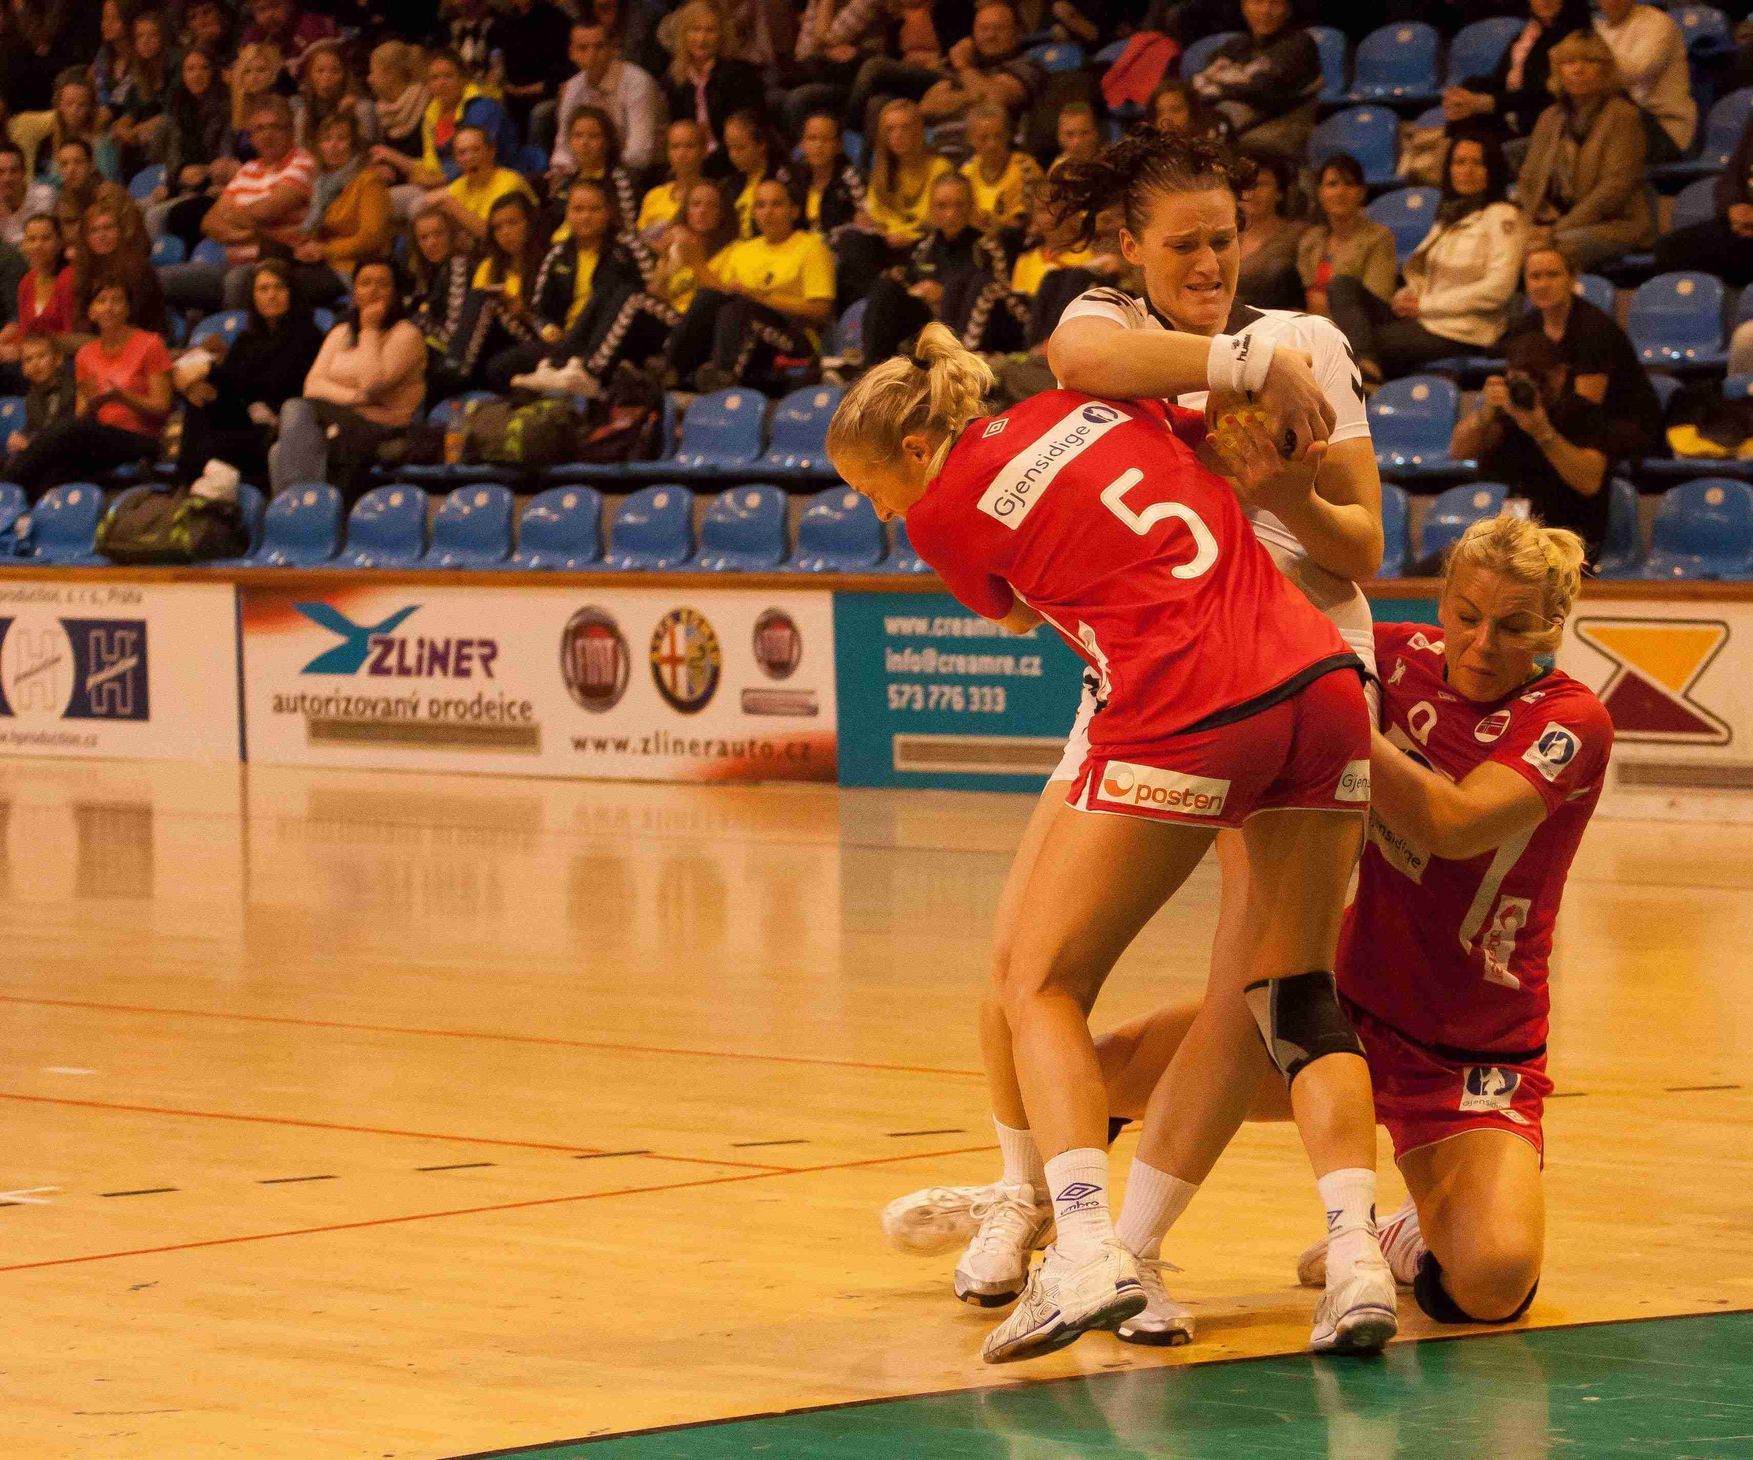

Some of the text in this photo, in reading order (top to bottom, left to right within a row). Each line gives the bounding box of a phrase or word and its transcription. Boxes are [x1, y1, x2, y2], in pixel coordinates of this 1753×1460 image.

[993, 424, 1091, 517] Gjensidige
[1099, 467, 1219, 580] 5
[887, 683, 1008, 714] 573 776 333
[1133, 782, 1224, 810] posten
[1060, 1200, 1100, 1216] umbro
